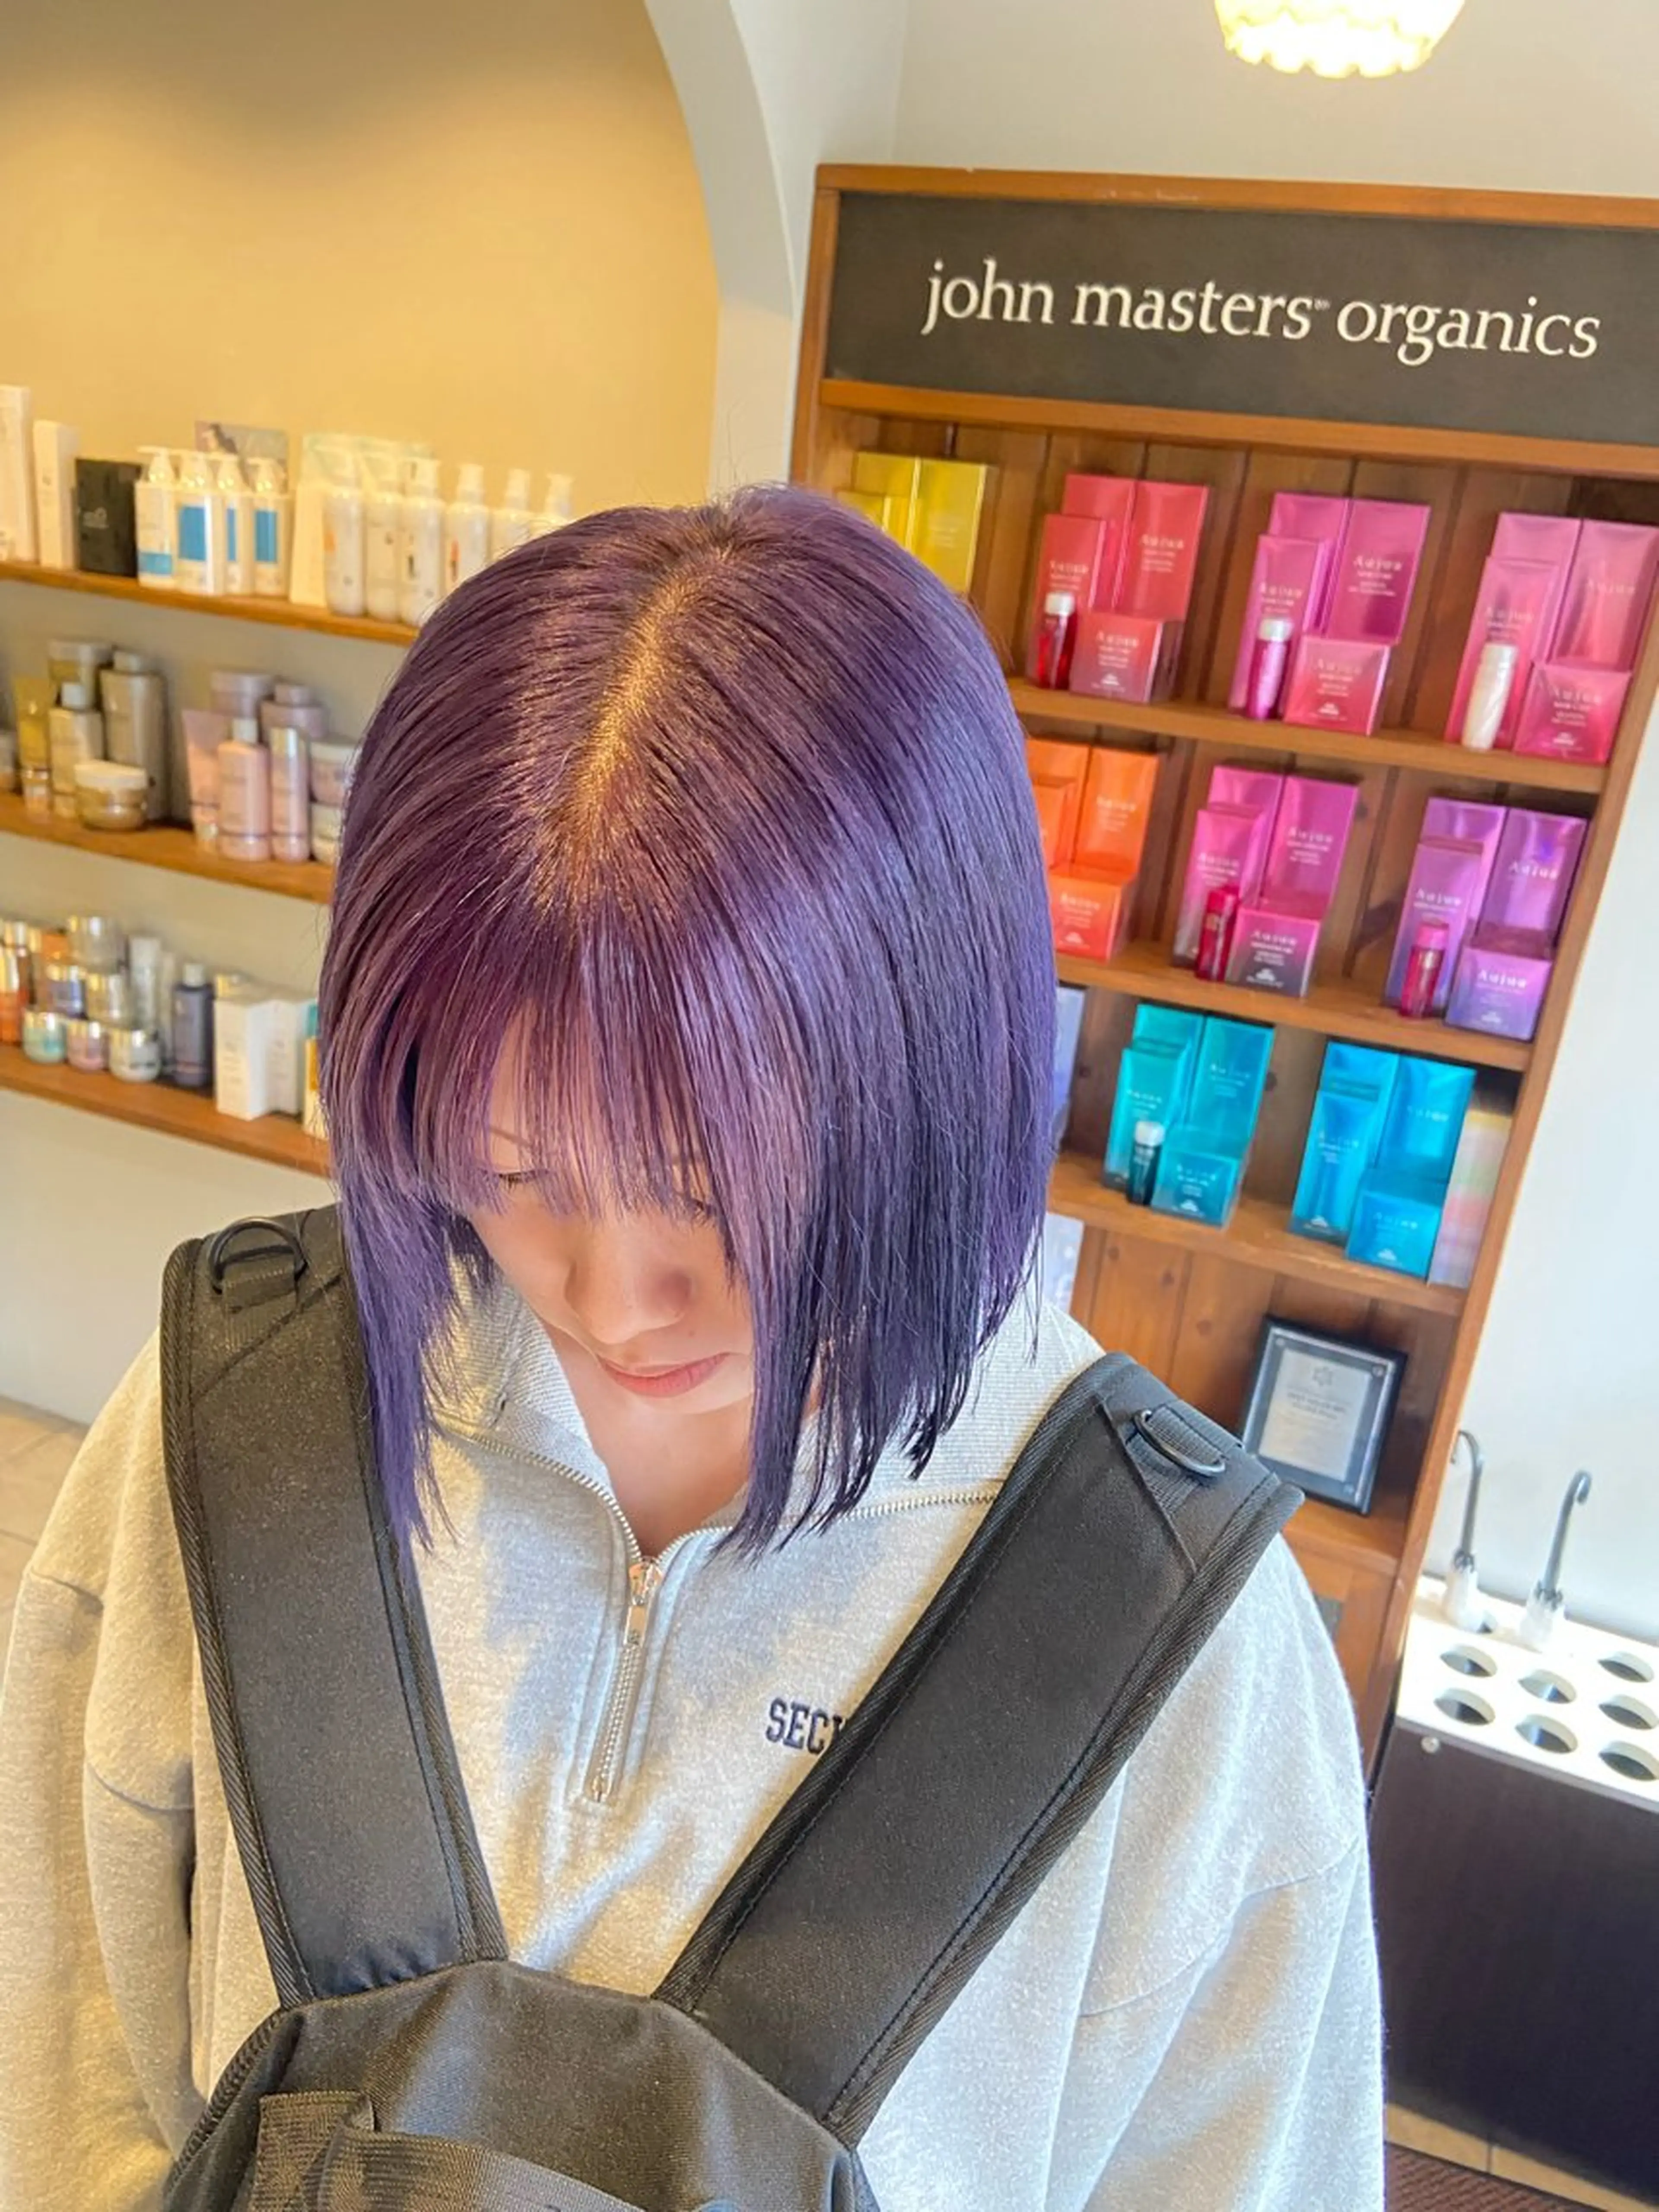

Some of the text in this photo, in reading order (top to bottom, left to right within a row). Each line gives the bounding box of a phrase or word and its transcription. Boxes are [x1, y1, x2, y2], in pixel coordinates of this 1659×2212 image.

[922, 259, 1601, 366] john masters organics
